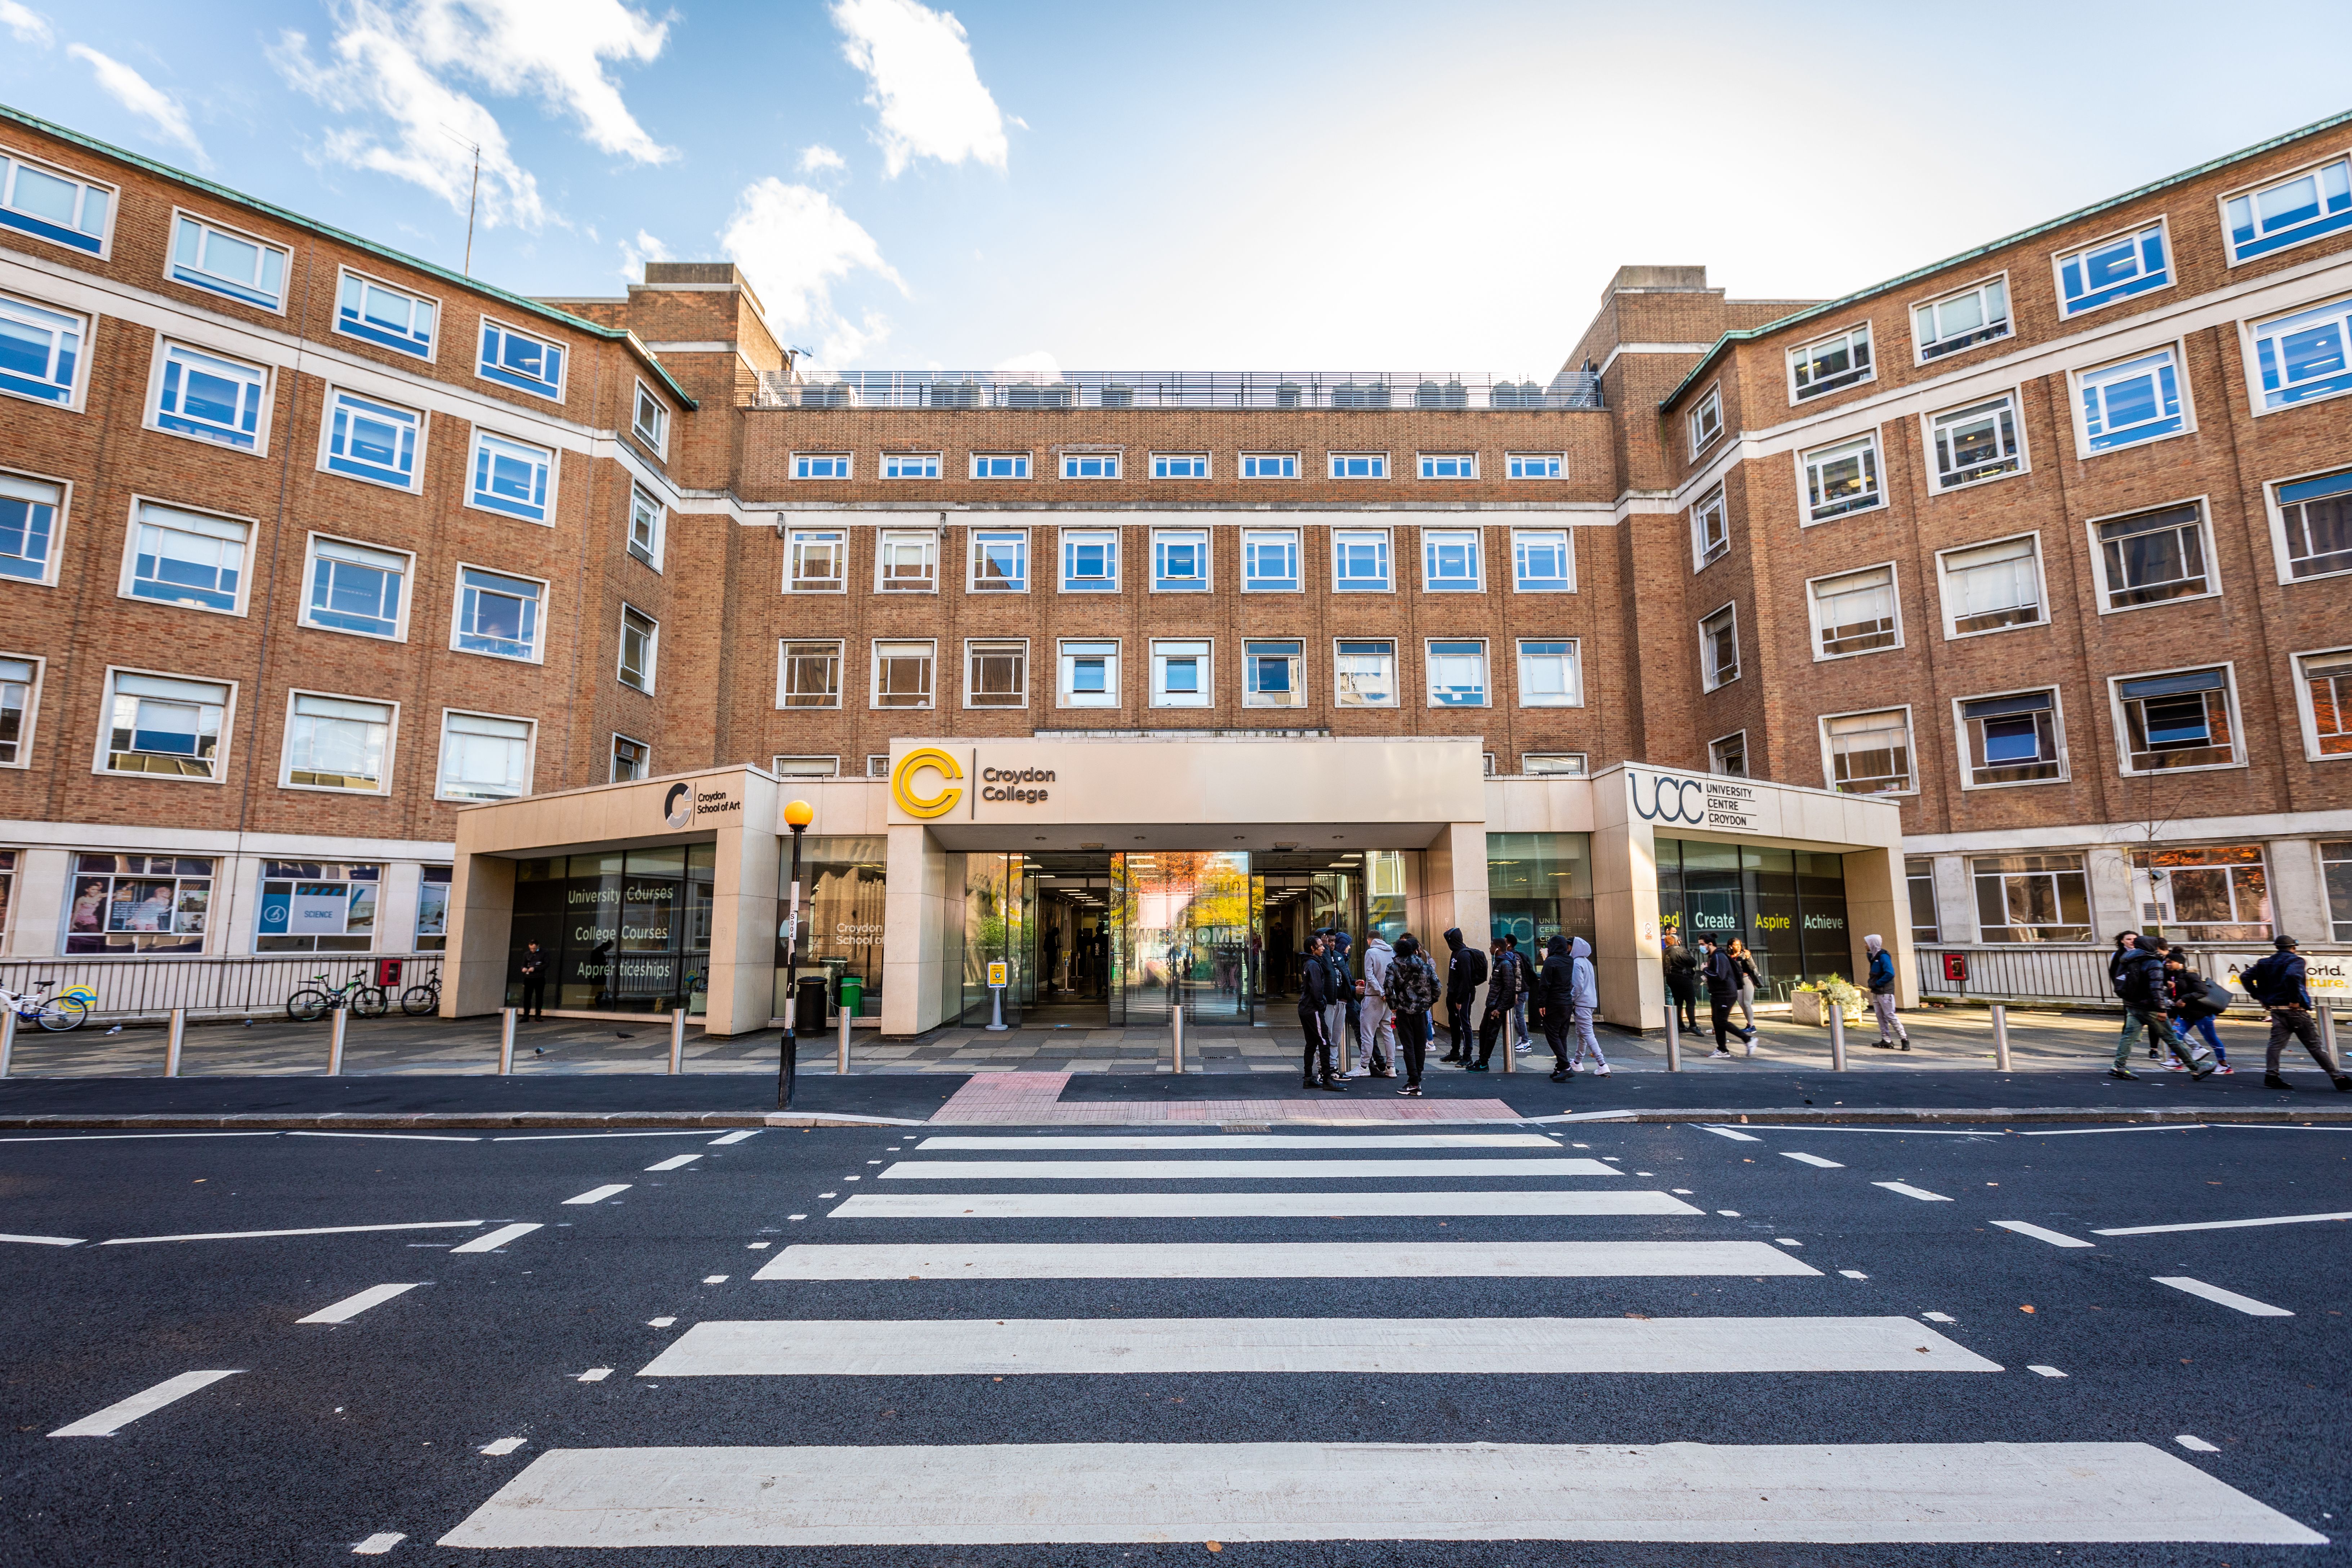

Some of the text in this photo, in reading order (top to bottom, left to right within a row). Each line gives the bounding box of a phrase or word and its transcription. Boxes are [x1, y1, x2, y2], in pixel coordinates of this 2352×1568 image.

[983, 767, 1056, 784] Croydon
[698, 791, 726, 802] Croydon
[982, 786, 1048, 804] College
[1706, 783, 1752, 798] UNIVERSITY
[1629, 773, 1704, 824] UCC
[1708, 799, 1739, 810] CENTRE
[697, 801, 740, 814] School of Art
[1709, 813, 1746, 825] CROYDON
[568, 886, 673, 904] University Courses
[1695, 912, 1735, 929] Create
[1755, 913, 1790, 931] Aspire
[1804, 914, 1843, 929] Achieve
[575, 925, 668, 942] College Courses
[836, 923, 882, 934] Croydon
[836, 934, 872, 945] School
[2227, 963, 2241, 973] A
[2307, 965, 2346, 976] orld.
[2229, 975, 2242, 984] A
